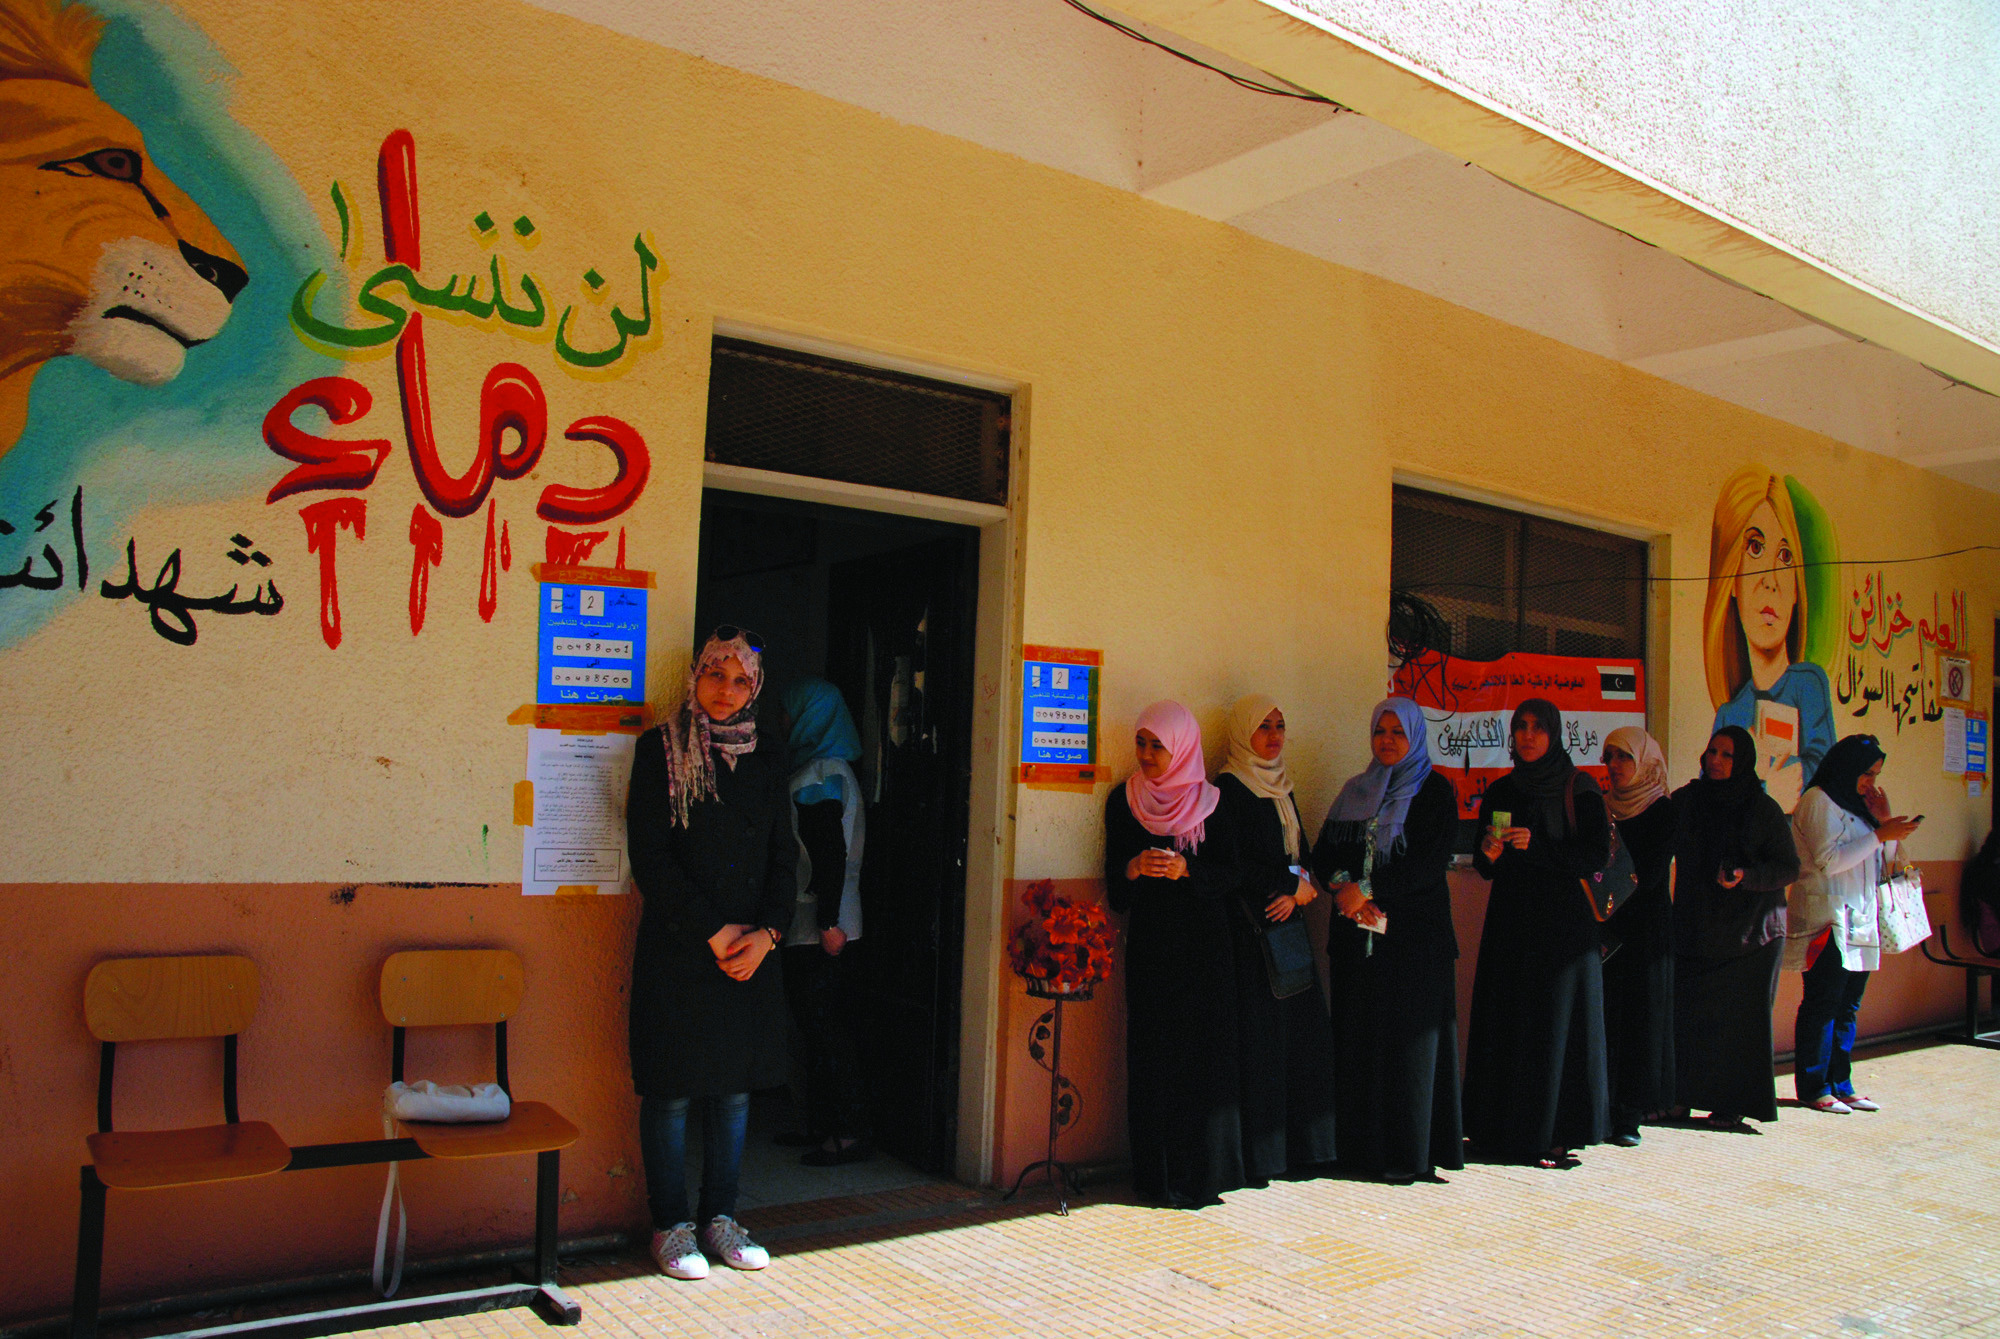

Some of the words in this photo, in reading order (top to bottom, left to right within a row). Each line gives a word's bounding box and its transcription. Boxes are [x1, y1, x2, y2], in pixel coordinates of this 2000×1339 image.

[555, 233, 657, 367] لن
[262, 129, 651, 525] دماء
[587, 595, 594, 609] 2
[1056, 672, 1063, 685] 2
[560, 689, 579, 700] هنا
[1565, 720, 1598, 755] مركز
[1038, 750, 1051, 759] هنا
